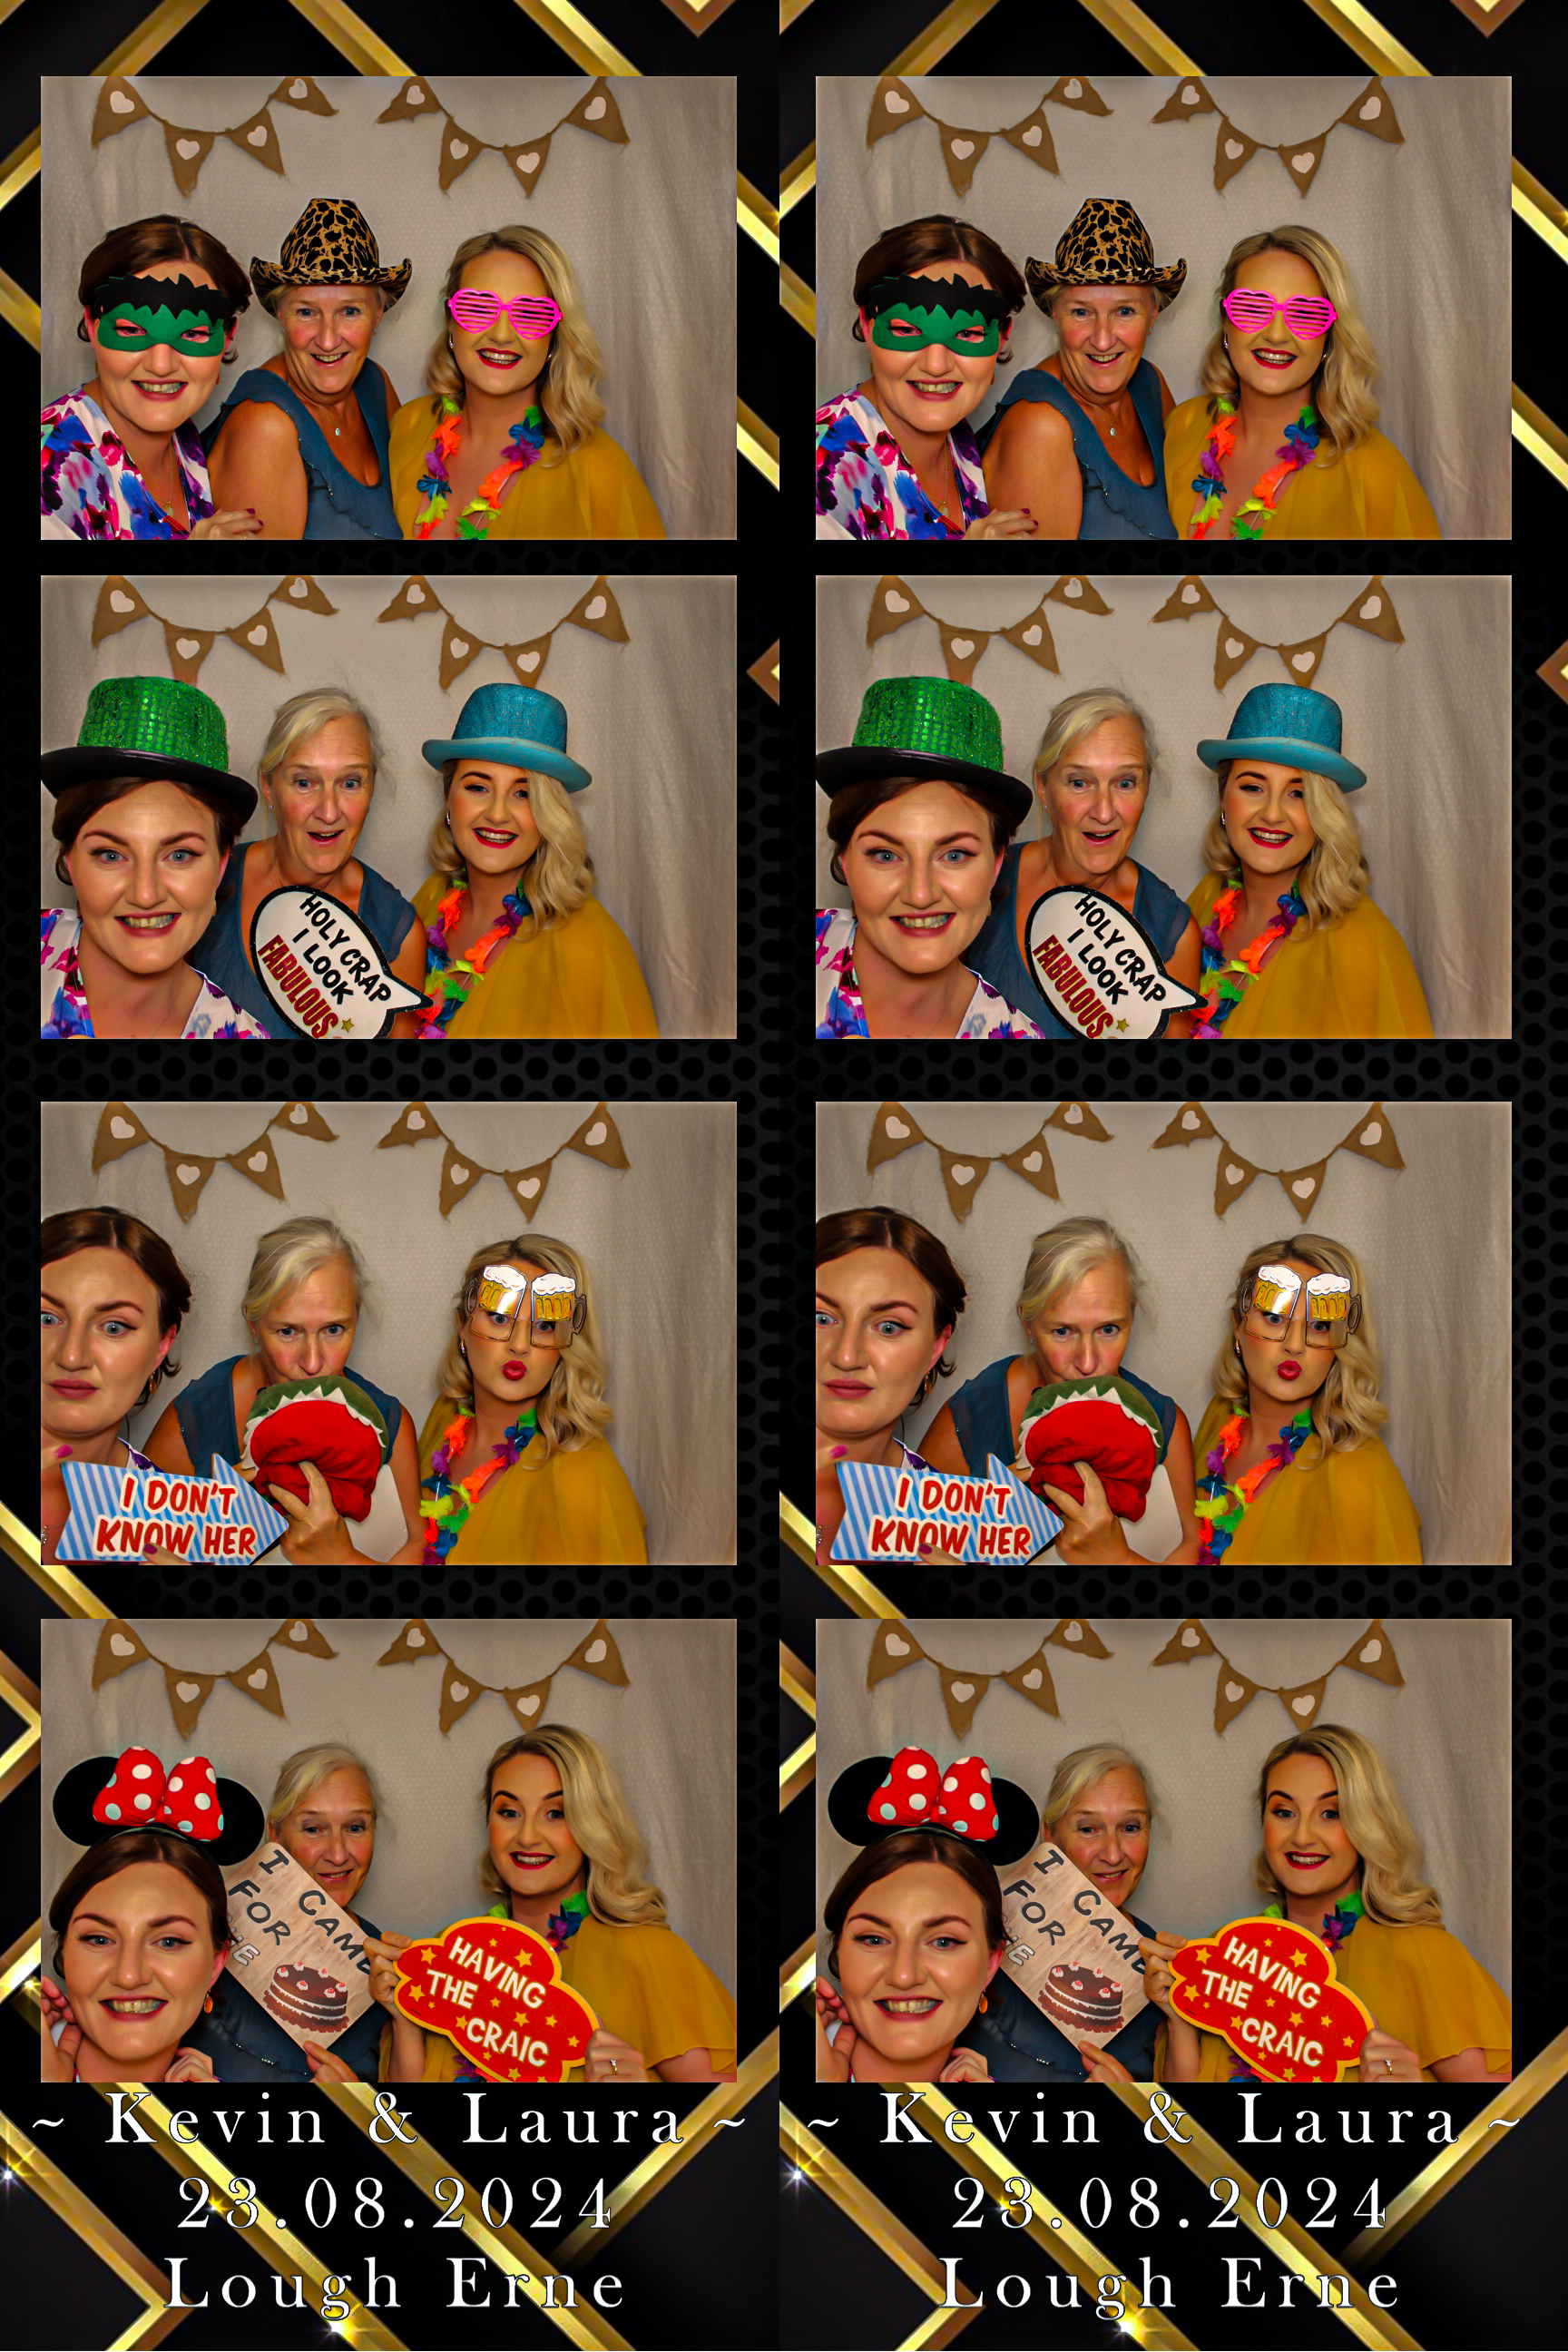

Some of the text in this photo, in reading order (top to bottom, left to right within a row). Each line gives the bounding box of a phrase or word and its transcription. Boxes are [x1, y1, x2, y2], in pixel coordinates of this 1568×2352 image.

[292, 928, 354, 1004] I LOOK
[299, 894, 391, 1002] HOLY CRAP
[1067, 928, 1129, 1004] I LOOK
[1074, 894, 1166, 1002] HOLY CRAP
[258, 935, 339, 1038] FABULOUS
[1033, 935, 1114, 1038] FABULOUS
[123, 1476, 236, 1516] I DON'T
[898, 1476, 1011, 1516] I DON'T
[96, 1518, 255, 1555] KNOW HER
[871, 1518, 1030, 1555] KNOW HER
[259, 1849, 289, 1875] I
[1034, 1849, 1064, 1875] I
[228, 1879, 291, 1945] FOR
[1003, 1879, 1066, 1945] FOR
[426, 1969, 478, 2009] THE
[449, 1936, 546, 2008] HAVING
[1201, 1969, 1253, 2009] THE
[1224, 1936, 1321, 2008] HAVING
[466, 2018, 549, 2066] CRAIC
[1241, 2018, 1324, 2066] CRAIC
